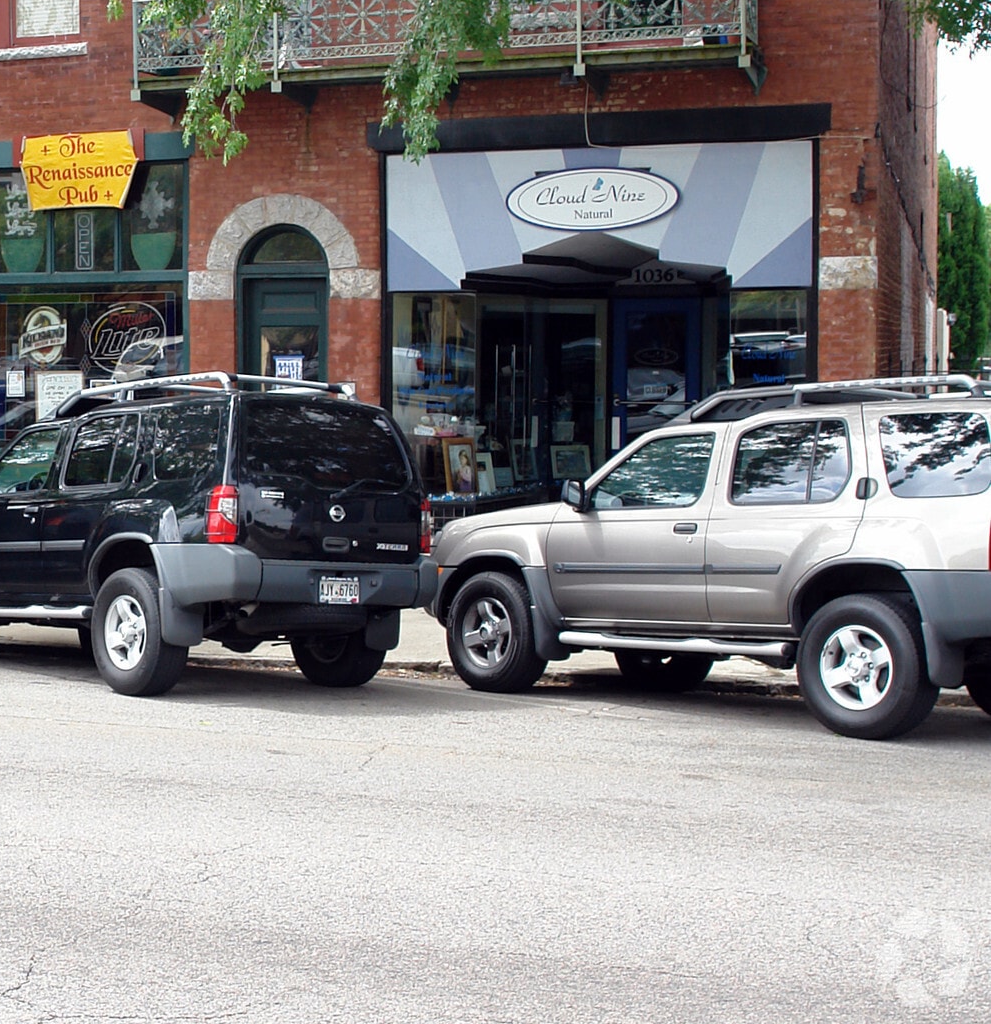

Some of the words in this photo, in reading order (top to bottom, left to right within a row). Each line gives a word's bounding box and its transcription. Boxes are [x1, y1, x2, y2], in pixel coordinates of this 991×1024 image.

[59, 135, 96, 158] The
[25, 163, 133, 190] Renaissance
[59, 184, 99, 206] Pub
[536, 184, 589, 206] Cloud
[592, 184, 647, 203] Nine
[574, 208, 614, 220] Natural
[78, 215, 91, 267] OPEN
[633, 268, 675, 283] 1036
[109, 311, 155, 328] Miller
[339, 583, 359, 597] 6760
